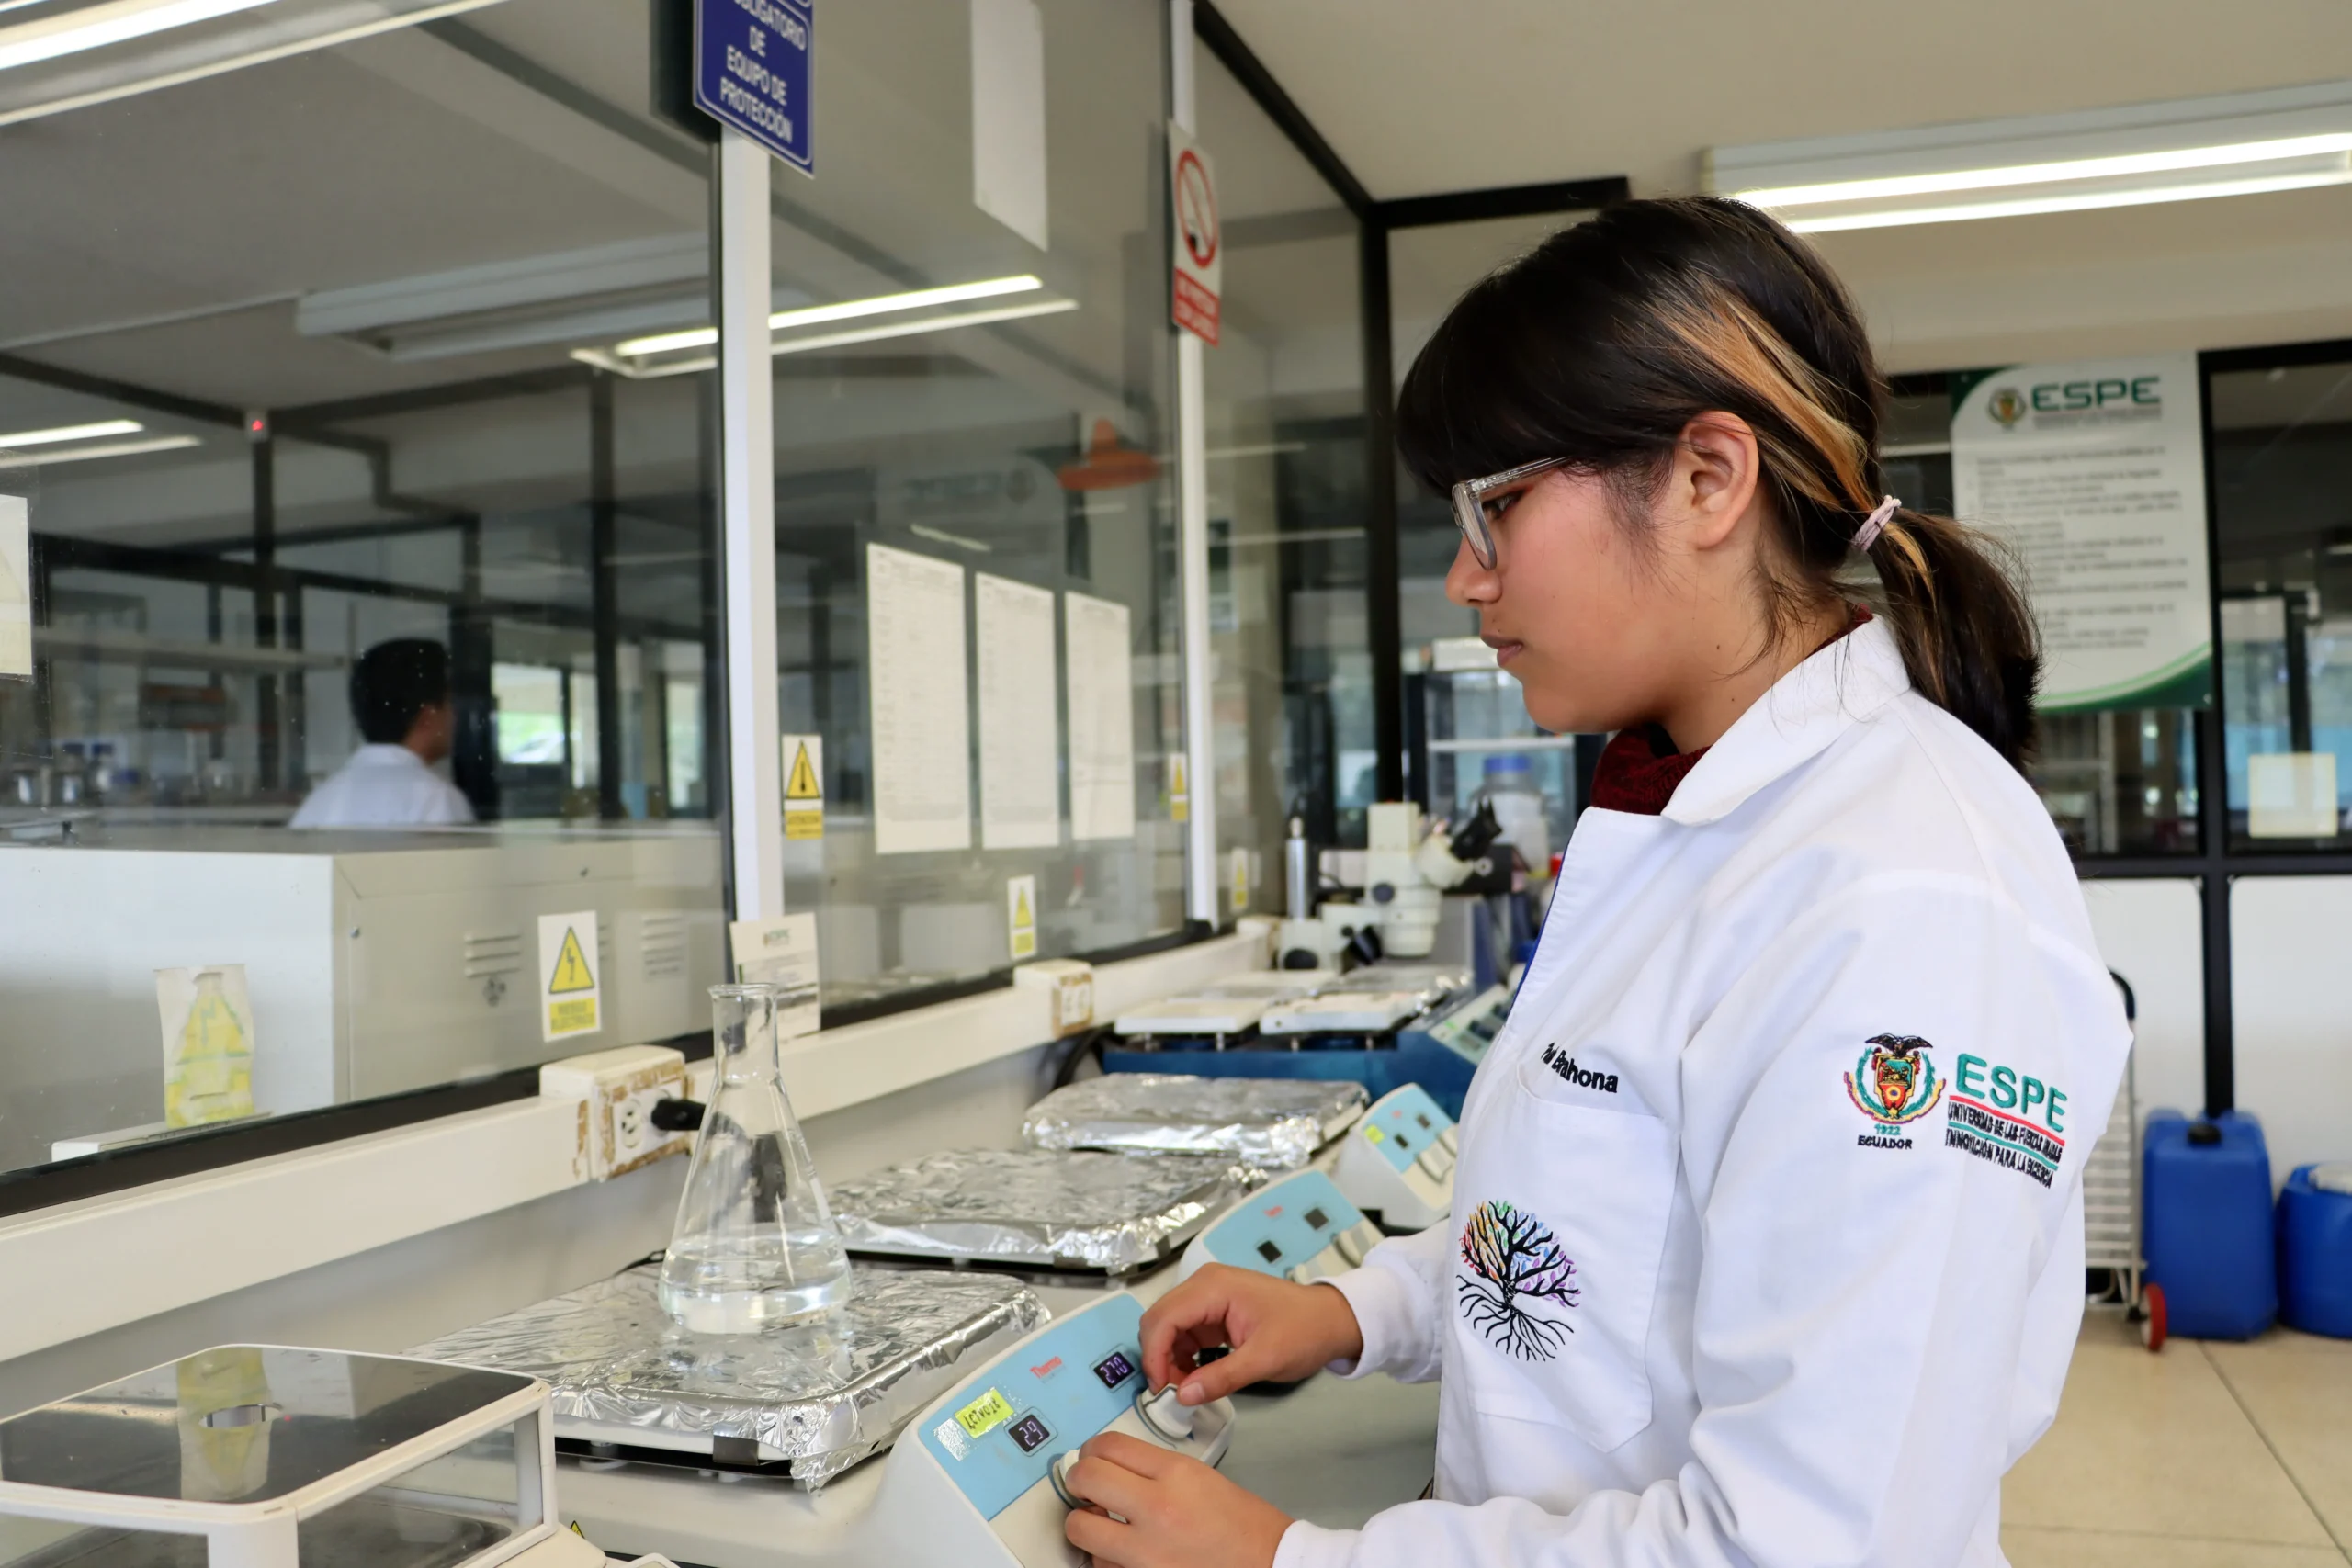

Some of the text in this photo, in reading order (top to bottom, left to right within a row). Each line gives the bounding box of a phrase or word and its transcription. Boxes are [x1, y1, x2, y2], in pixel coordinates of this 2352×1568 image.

[732, 0, 807, 51] LIGATORIO
[749, 25, 766, 57] DE
[727, 44, 787, 106] EQUIPO DE
[719, 76, 793, 143] PROTECCIÓN
[2031, 376, 2161, 412] ESPE
[1956, 1053, 2068, 1132] ESPE
[1858, 1134, 1913, 1149] ECUADOR
[1874, 1123, 1901, 1135] 1922
[1993, 1145, 2018, 1171] PARA
[1099, 1356, 1128, 1384] 270
[1018, 1420, 1044, 1447] 29
